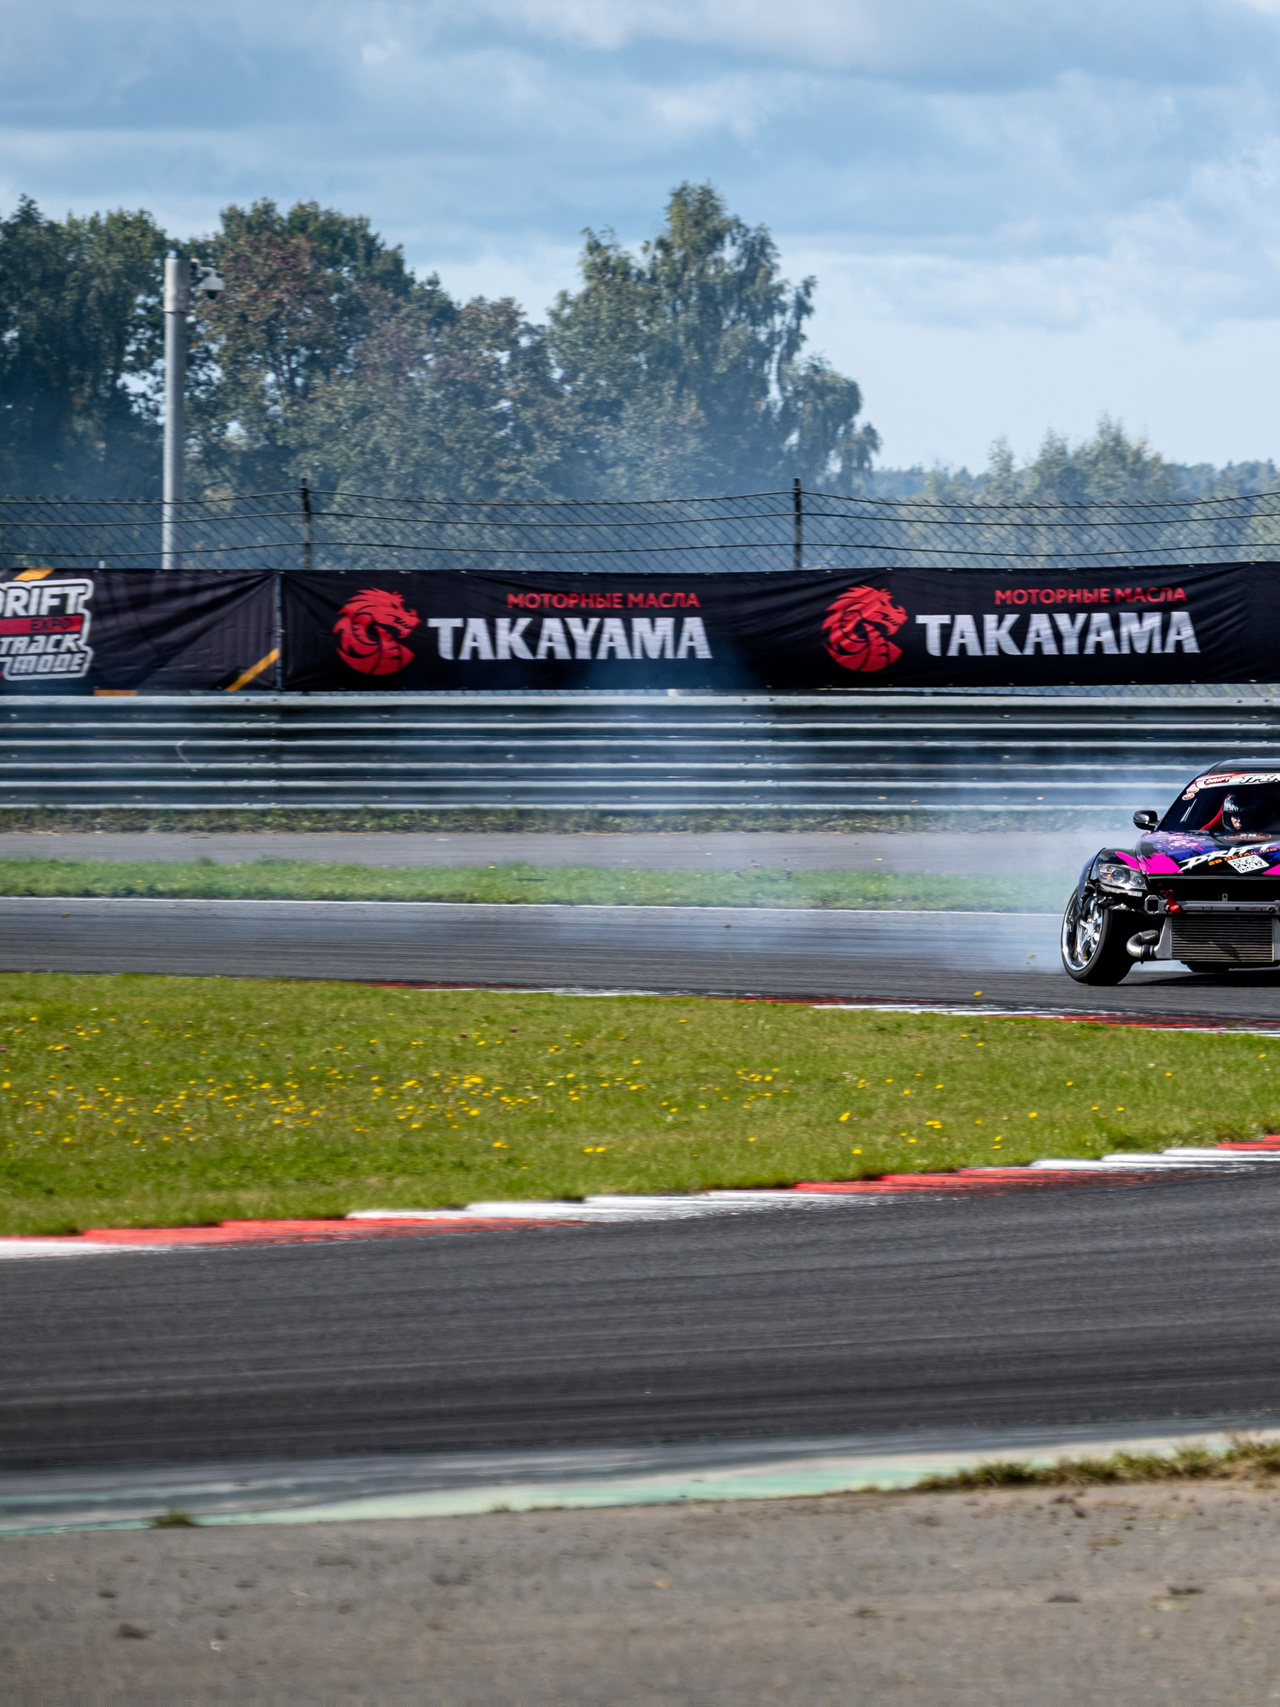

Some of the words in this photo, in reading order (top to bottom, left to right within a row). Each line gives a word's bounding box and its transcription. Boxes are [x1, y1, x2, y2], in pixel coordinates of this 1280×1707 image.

[0, 585, 87, 617] RIFT
[506, 592, 623, 609] МОТОРНЫЕ
[627, 592, 701, 608] МАСЛА
[994, 588, 1111, 605] МОТОРНЫЕ
[1114, 587, 1188, 603] МАСЛА
[30, 618, 72, 631] EXPO
[915, 611, 1201, 657] TAKAYAMA
[427, 616, 713, 661] TAKAYAMA
